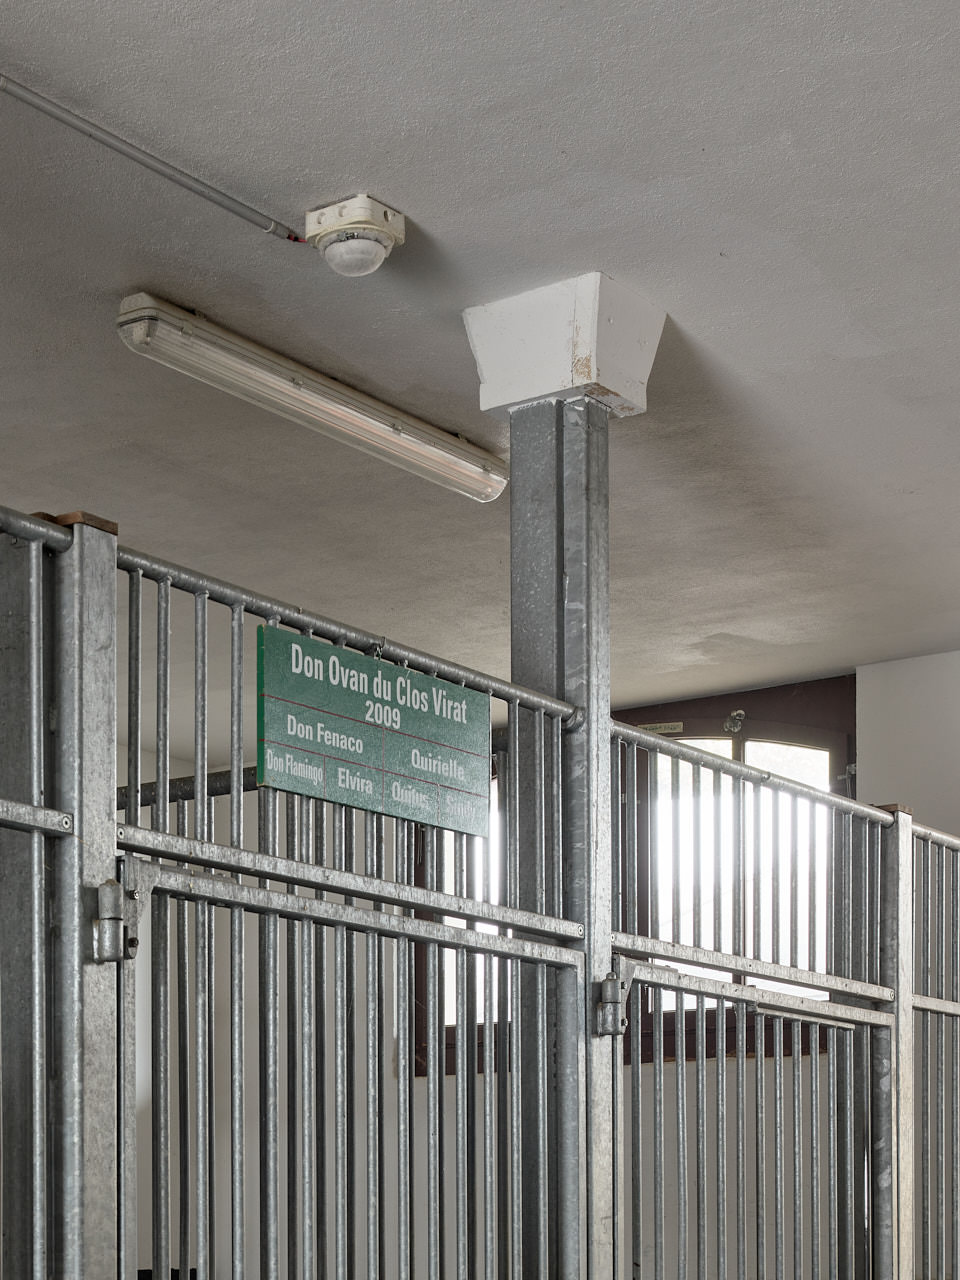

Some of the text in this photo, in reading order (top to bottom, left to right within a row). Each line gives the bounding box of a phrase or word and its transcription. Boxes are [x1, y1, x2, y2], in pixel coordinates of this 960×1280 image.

[291, 643, 468, 724] Don Ovan du Clos Virat
[365, 700, 401, 730] 2009
[287, 714, 363, 754] Don Fenaco
[267, 749, 323, 786] Don Flamingo
[338, 767, 373, 794] Elvira
[411, 749, 465, 782] Quirielle
